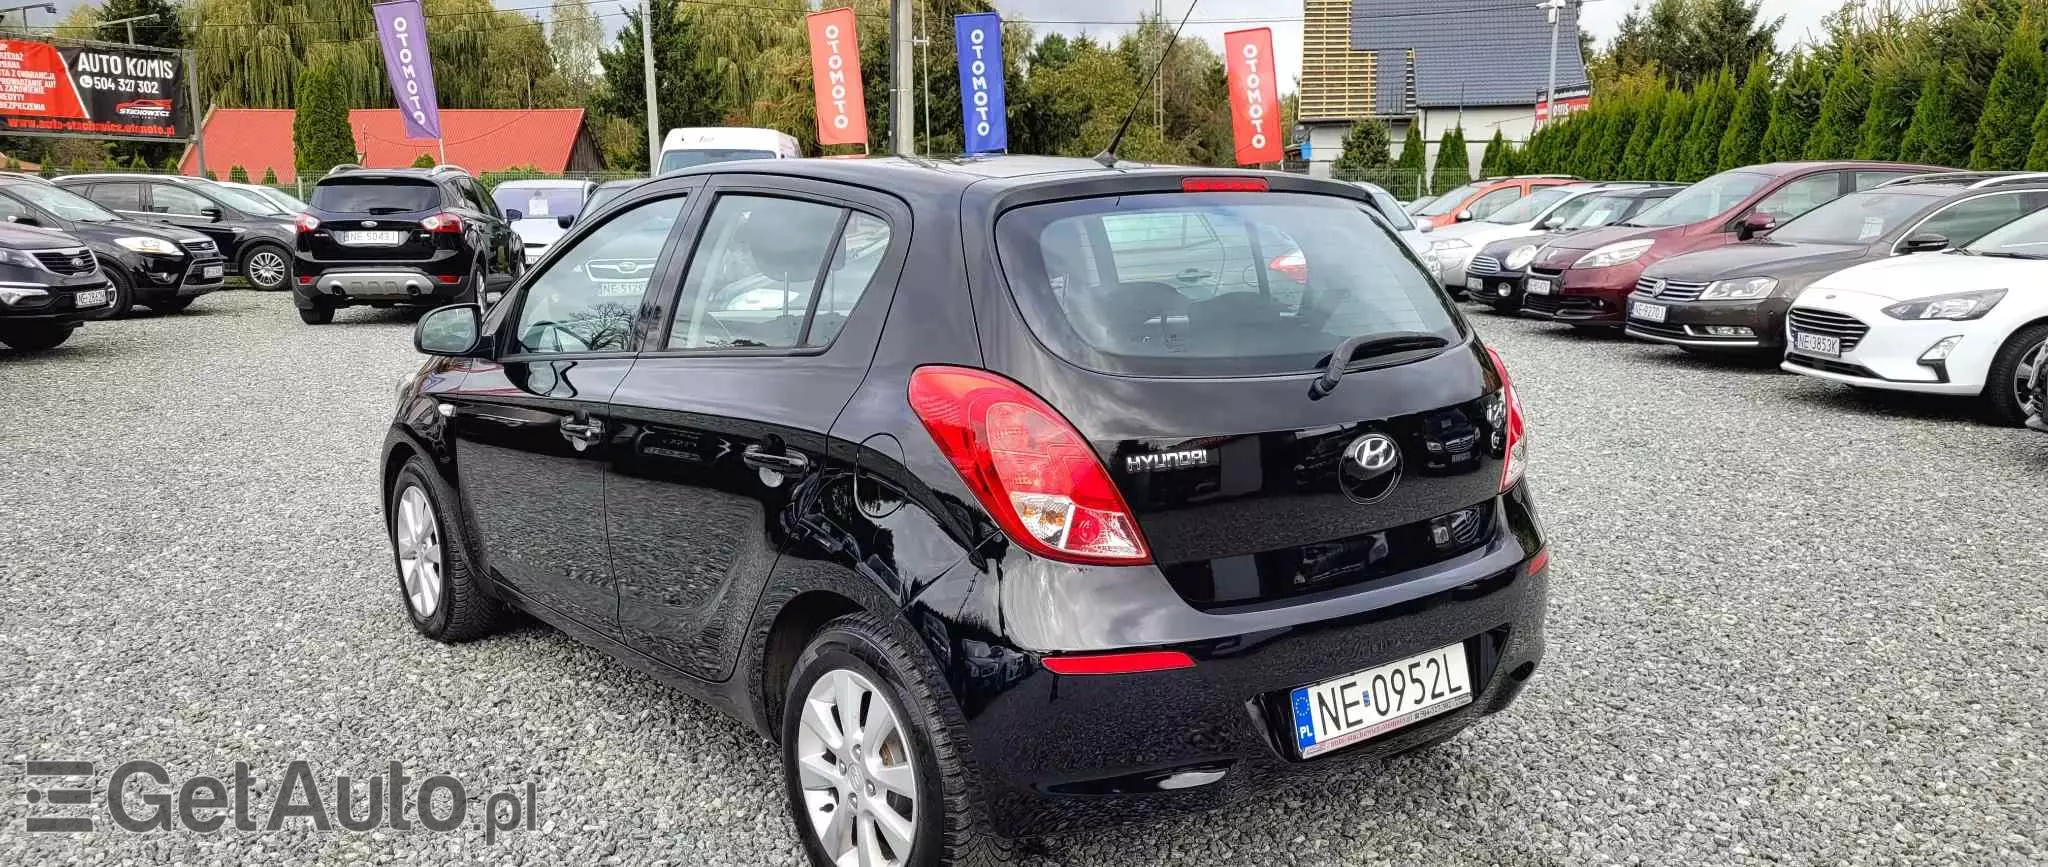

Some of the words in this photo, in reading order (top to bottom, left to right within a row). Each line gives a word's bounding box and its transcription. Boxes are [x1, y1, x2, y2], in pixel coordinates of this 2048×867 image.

[78, 52, 122, 75] AUTO
[126, 57, 174, 79] KOMIS
[94, 78, 116, 90] 504
[118, 79, 135, 92] 327
[137, 81, 160, 94] 302
[394, 17, 425, 125] OTOMOTO
[824, 25, 848, 129] OTOMOTO
[971, 29, 990, 136] OTOMOTO
[1242, 43, 1266, 149] OTOMOTO
[1799, 335, 1809, 349] NE
[1811, 338, 1838, 354] 3853K
[1127, 449, 1207, 472] HYUNDAI
[1317, 681, 1364, 735] NE
[1371, 653, 1462, 717] 0952L
[1300, 726, 1313, 739] PL
